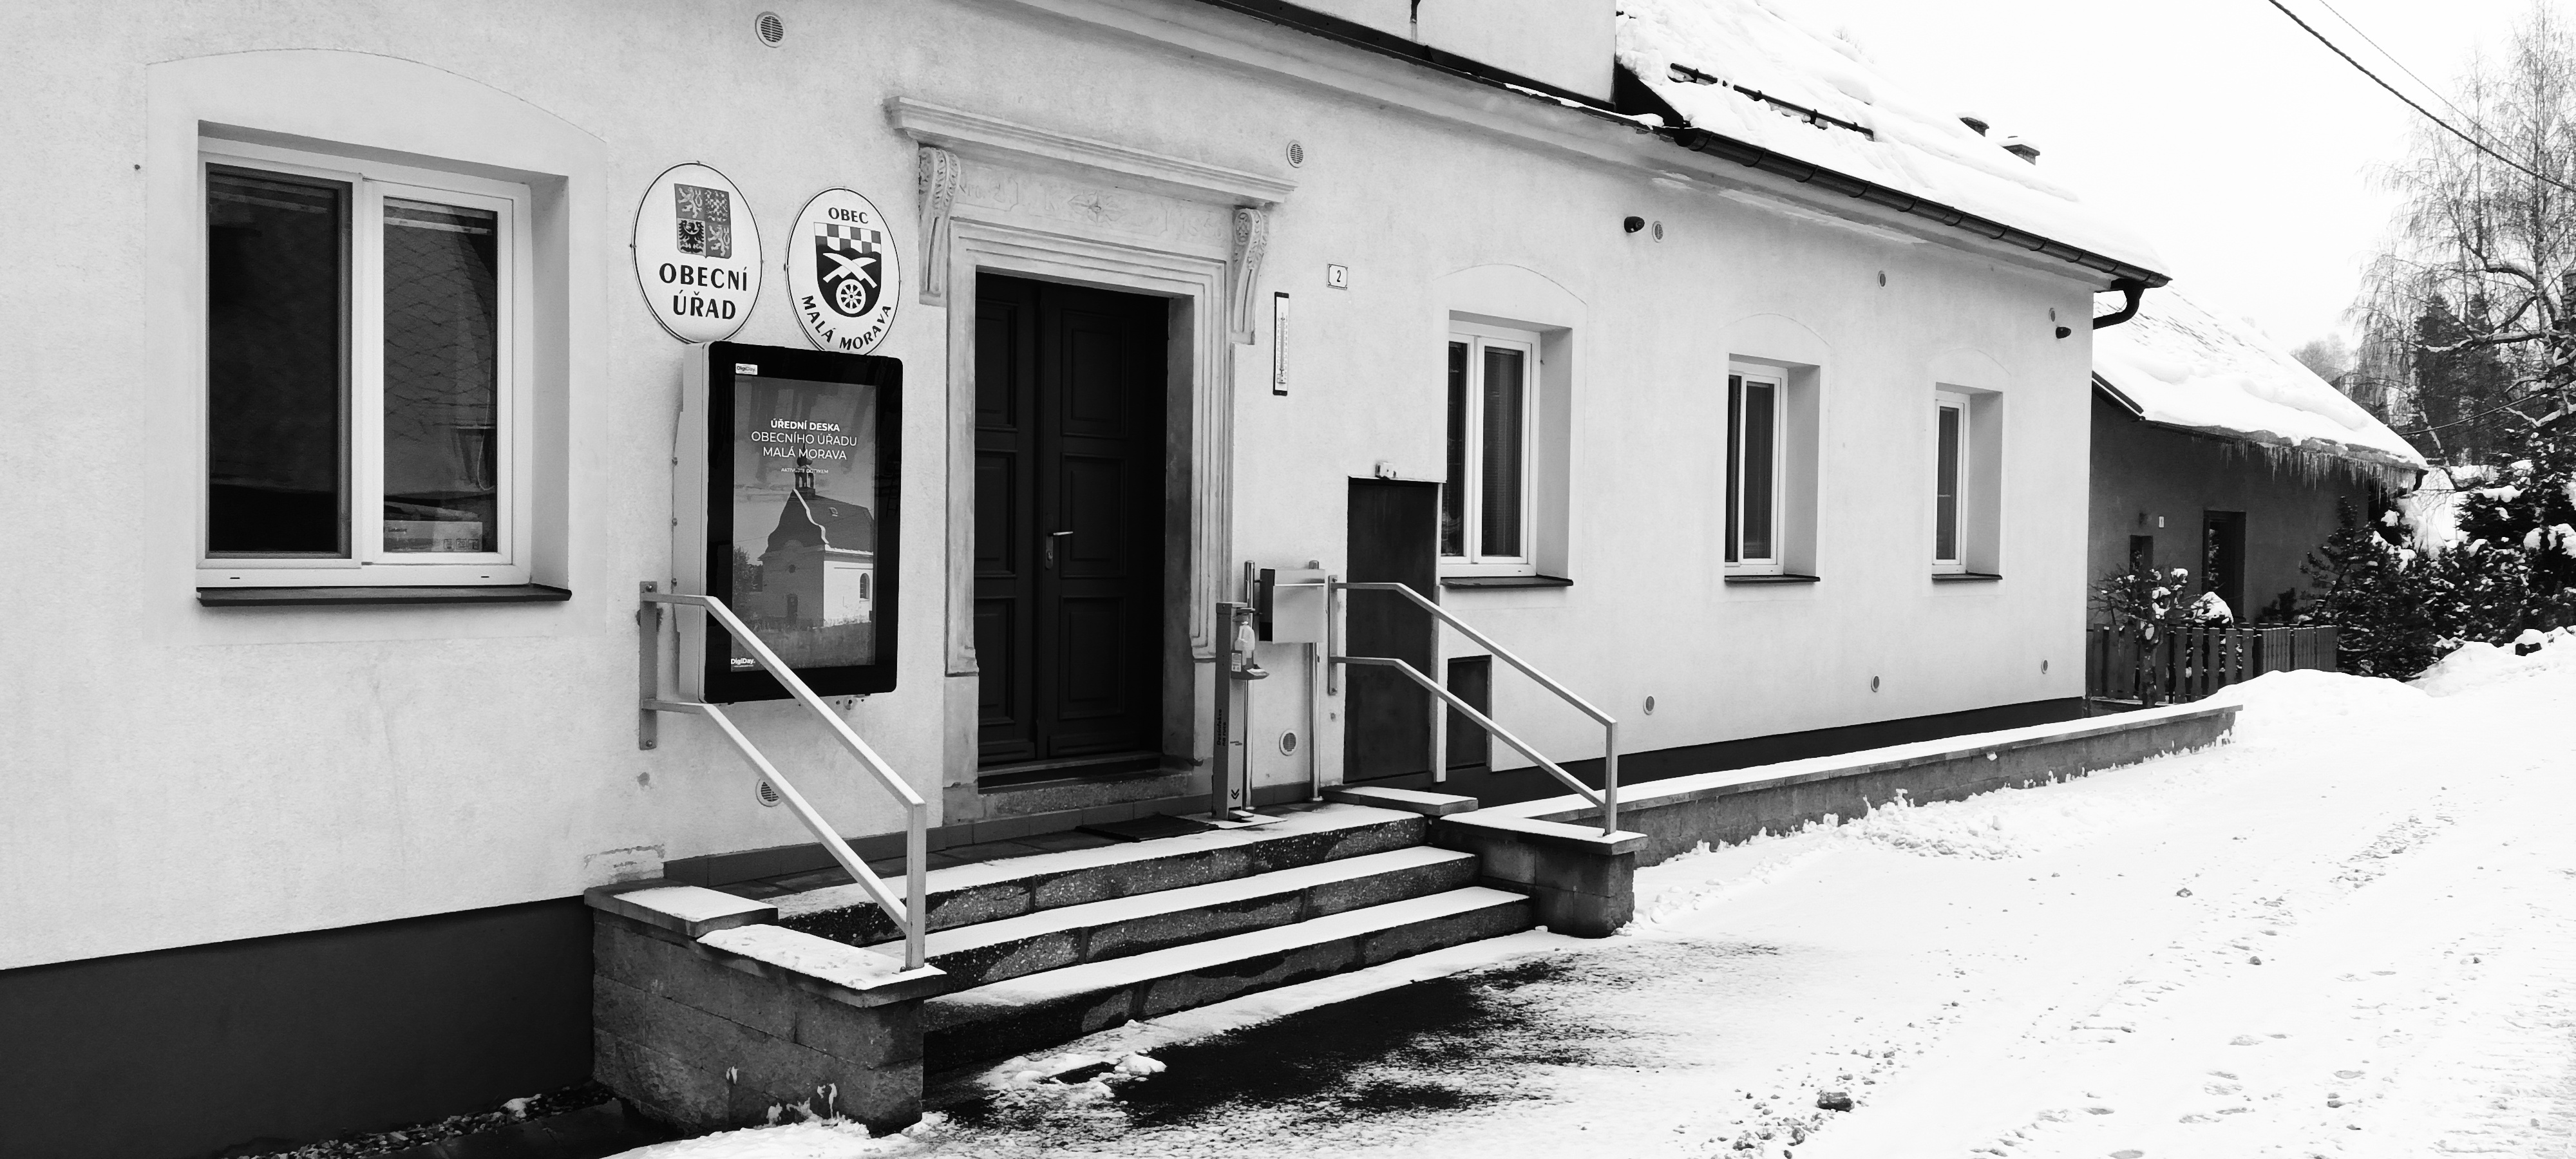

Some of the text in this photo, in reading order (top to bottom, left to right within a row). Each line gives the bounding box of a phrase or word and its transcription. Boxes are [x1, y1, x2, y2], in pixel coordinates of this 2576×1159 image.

[828, 207, 869, 224] OBEC
[659, 263, 748, 291] OBECNÍ
[1336, 270, 1341, 283] 2
[673, 290, 736, 320] ÚŘAD
[802, 296, 891, 351] MALÁ MORAVA
[771, 419, 840, 432] ÚŘEDNÍ DESKA
[751, 431, 857, 446] OBECNÍHO ÚŘADU
[763, 446, 847, 460] MALÁ MORAVA
